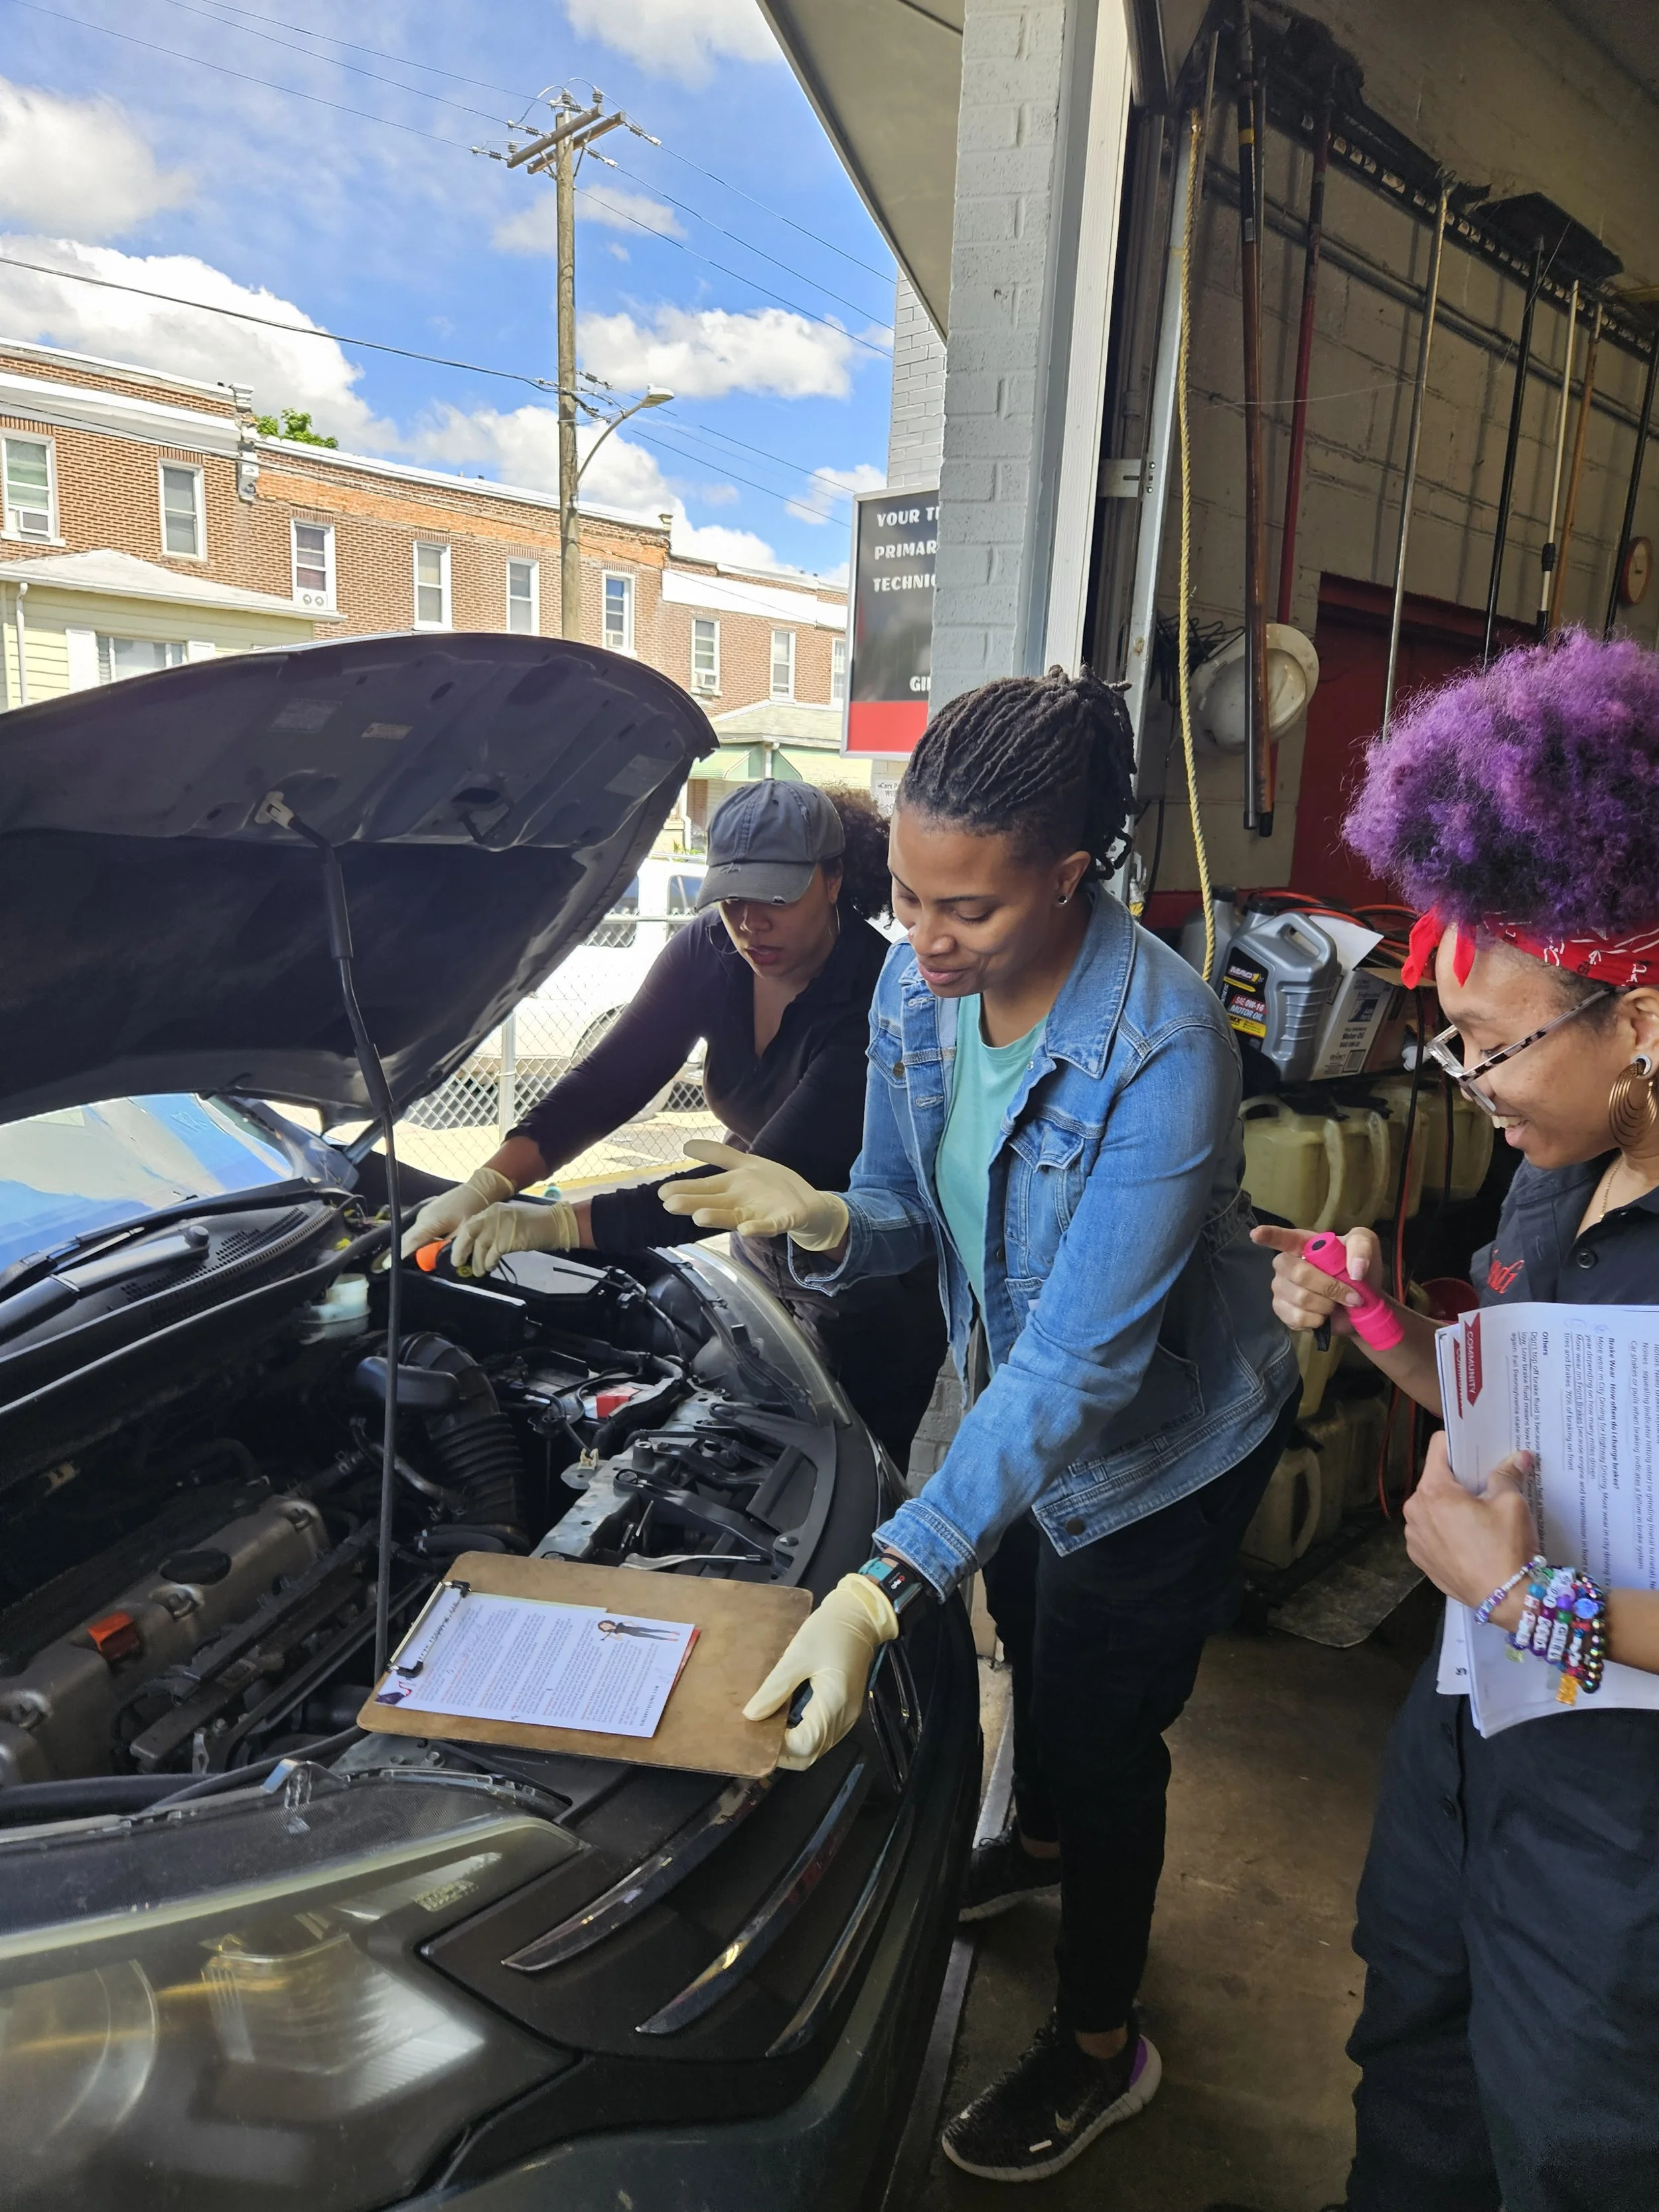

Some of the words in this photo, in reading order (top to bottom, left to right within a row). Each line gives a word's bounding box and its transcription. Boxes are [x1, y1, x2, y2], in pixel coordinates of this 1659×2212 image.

[877, 509, 920, 527] YOUR
[874, 540, 937, 559] PRIMAR
[1229, 1004, 1253, 1017] MOTOR
[1252, 1012, 1263, 1021] OIL
[1235, 996, 1246, 1006] SAE
[1245, 998, 1265, 1011] 0W-16
[1608, 1338, 1617, 1358] Brake
[1467, 1331, 1476, 1393] COMMUNITY
[1529, 1352, 1538, 1364] top
[1577, 1371, 1582, 1380] on
[1585, 1351, 1594, 1388] depending
[1609, 1360, 1617, 1378] Wear
[1512, 1368, 1521, 1415] Pennsylvania
[1588, 1389, 1593, 1399] on
[1596, 1382, 1606, 1395] City
[1566, 1406, 1573, 1415] of
[1576, 1401, 1585, 1425] Brakes
[1565, 1416, 1574, 1442] braking
[1586, 1417, 1595, 1437] many
[1612, 1421, 1619, 1431] do
[1567, 1443, 1573, 1453] on
[1610, 1436, 1619, 1461] change
[1580, 1495, 1589, 1540] transmission
